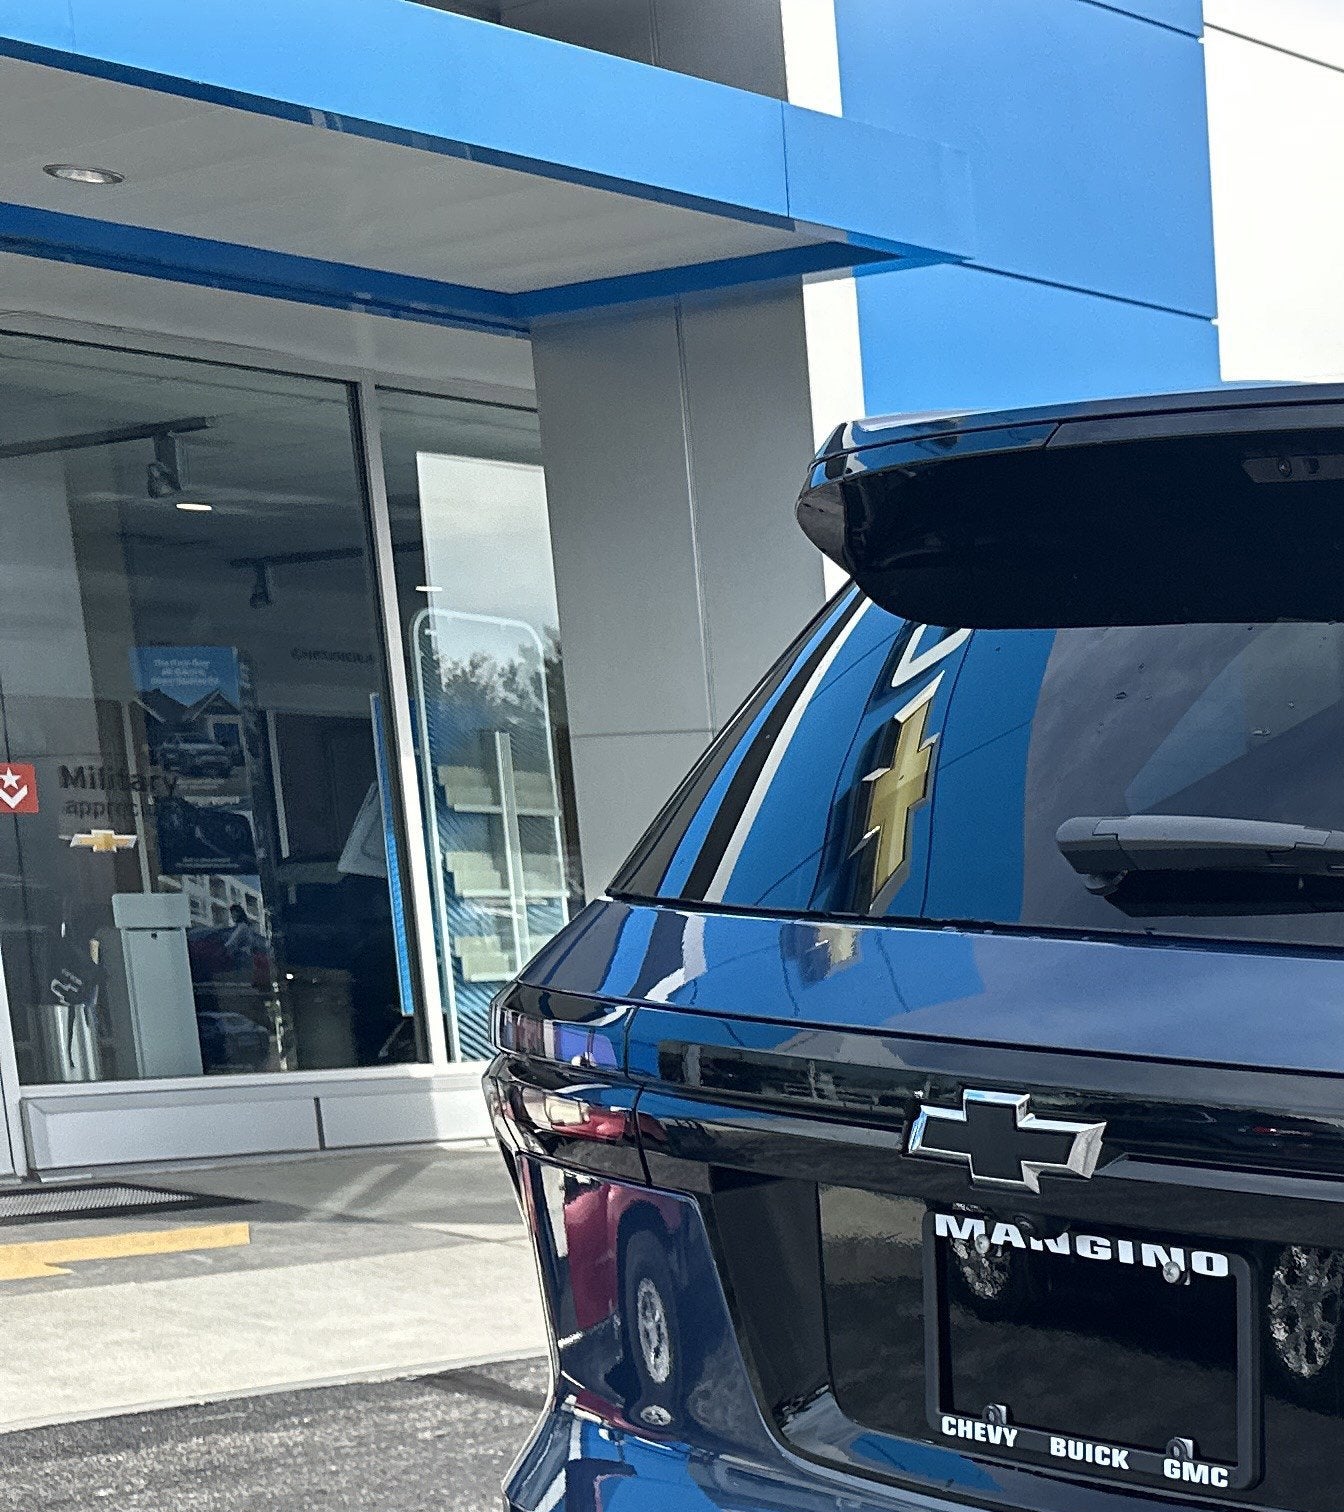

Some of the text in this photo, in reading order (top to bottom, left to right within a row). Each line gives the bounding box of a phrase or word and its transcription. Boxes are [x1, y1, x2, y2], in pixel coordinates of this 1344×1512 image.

[57, 763, 178, 799] Military
[934, 1213, 1229, 1286] MANGINO
[941, 1415, 1229, 1488] CHEVY BUICK GMC
